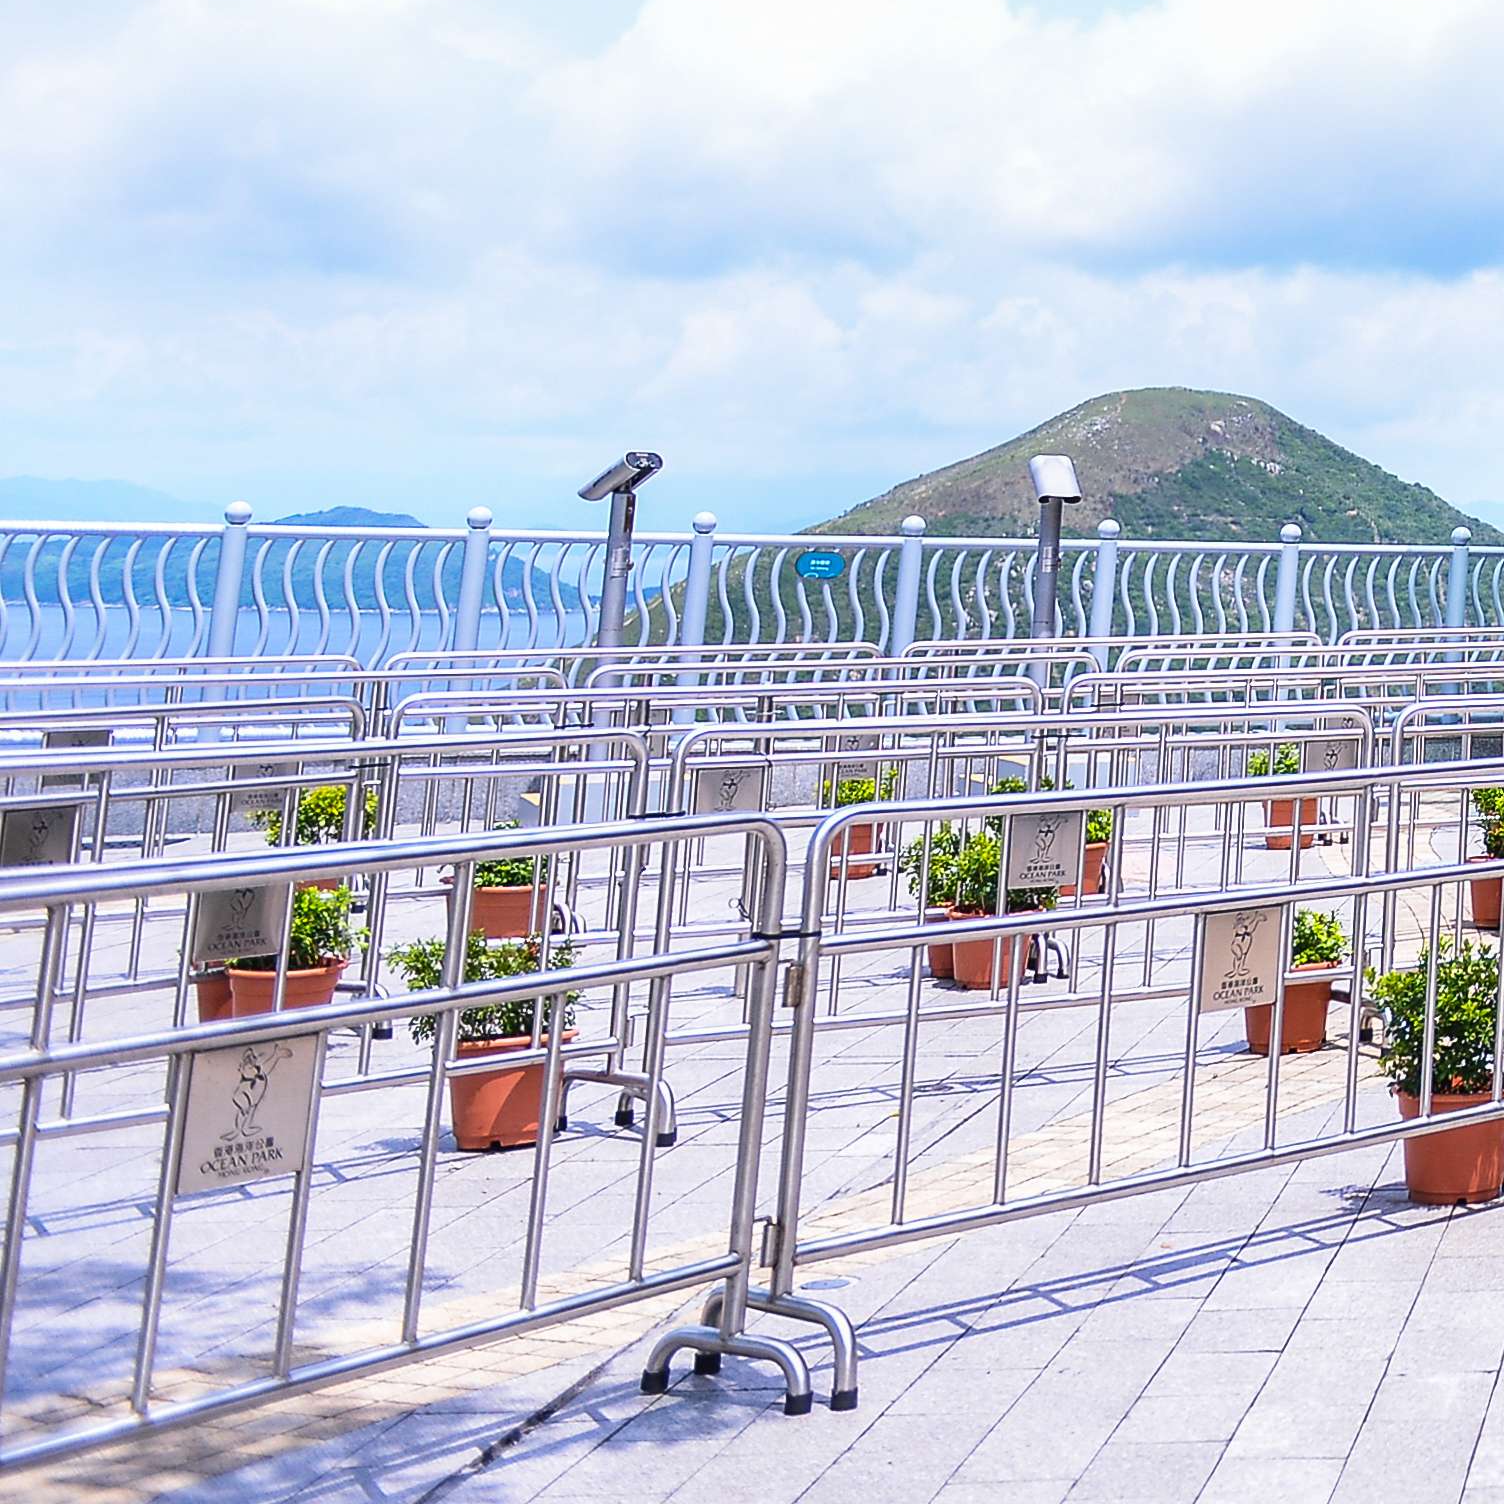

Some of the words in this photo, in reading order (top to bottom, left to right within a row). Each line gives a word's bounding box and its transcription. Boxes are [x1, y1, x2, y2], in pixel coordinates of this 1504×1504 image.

[1212, 988, 1242, 1000] OCEAN
[199, 1154, 247, 1175] OCEAN
[251, 1146, 284, 1165] PARK
